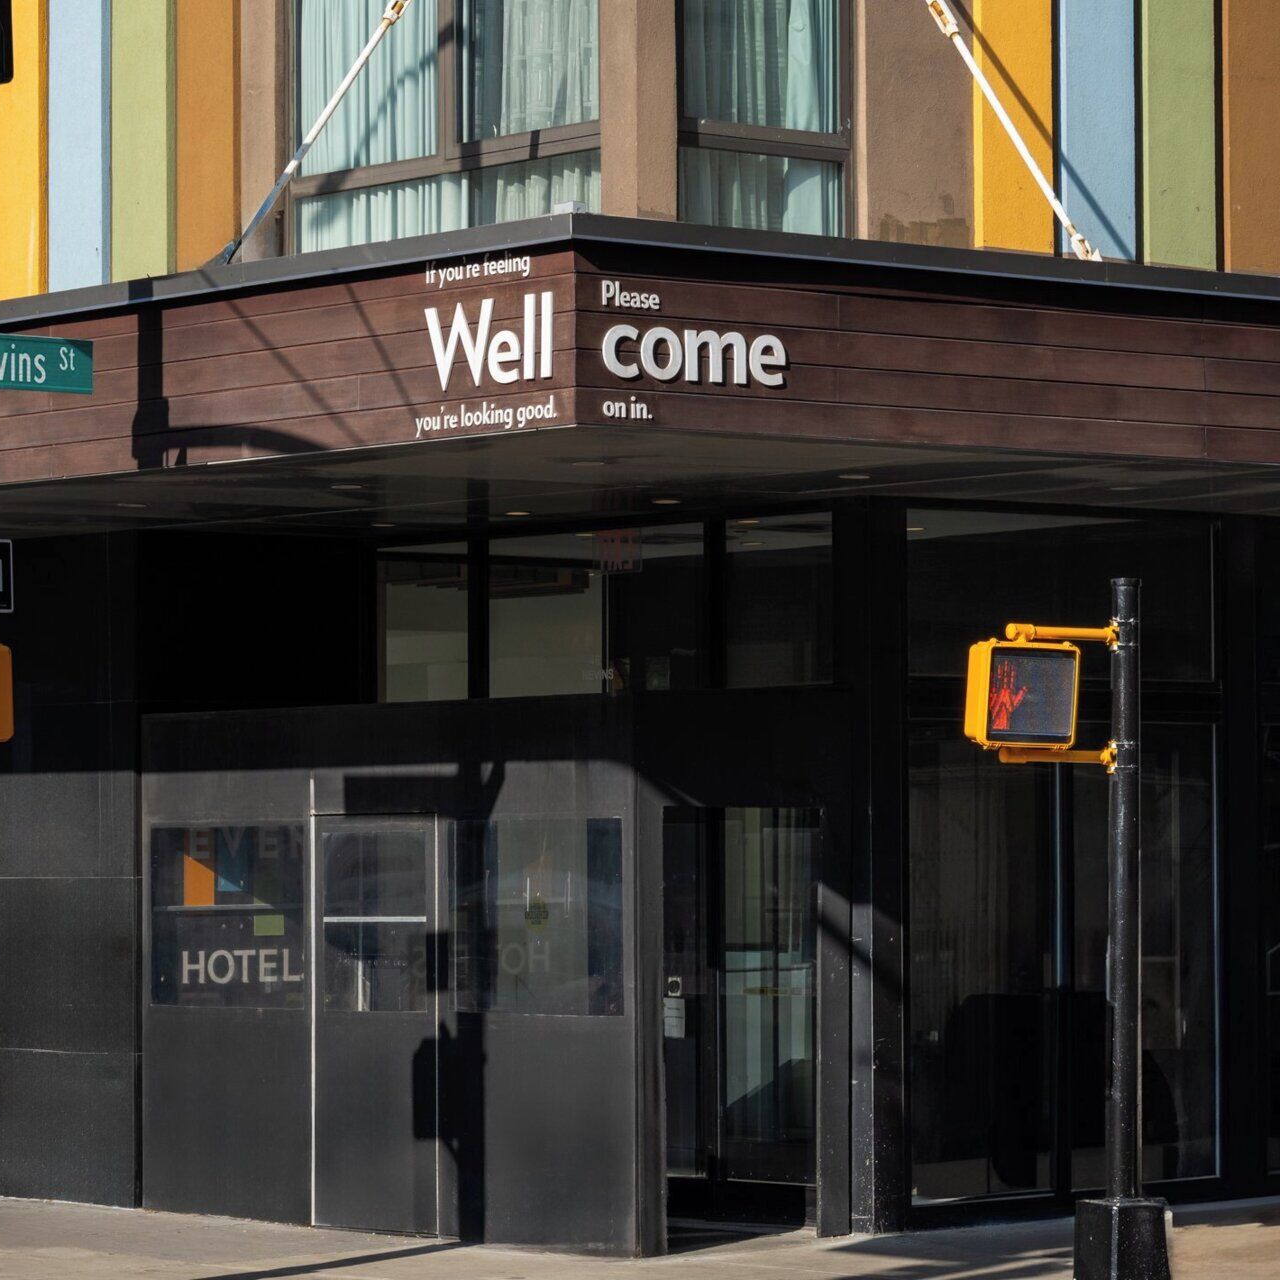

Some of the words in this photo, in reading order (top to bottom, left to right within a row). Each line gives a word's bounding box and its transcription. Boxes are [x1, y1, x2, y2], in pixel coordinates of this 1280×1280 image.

[438, 256, 480, 288] you're
[483, 251, 530, 278] feeling
[601, 280, 660, 310] Please
[59, 346, 76, 371] St
[424, 291, 553, 392] Well
[601, 324, 787, 386] come
[415, 405, 458, 438] you're
[460, 401, 513, 429] looking
[516, 395, 557, 428] good.
[602, 400, 626, 419] on
[630, 396, 654, 420] in.
[182, 948, 304, 984] HOTEL
